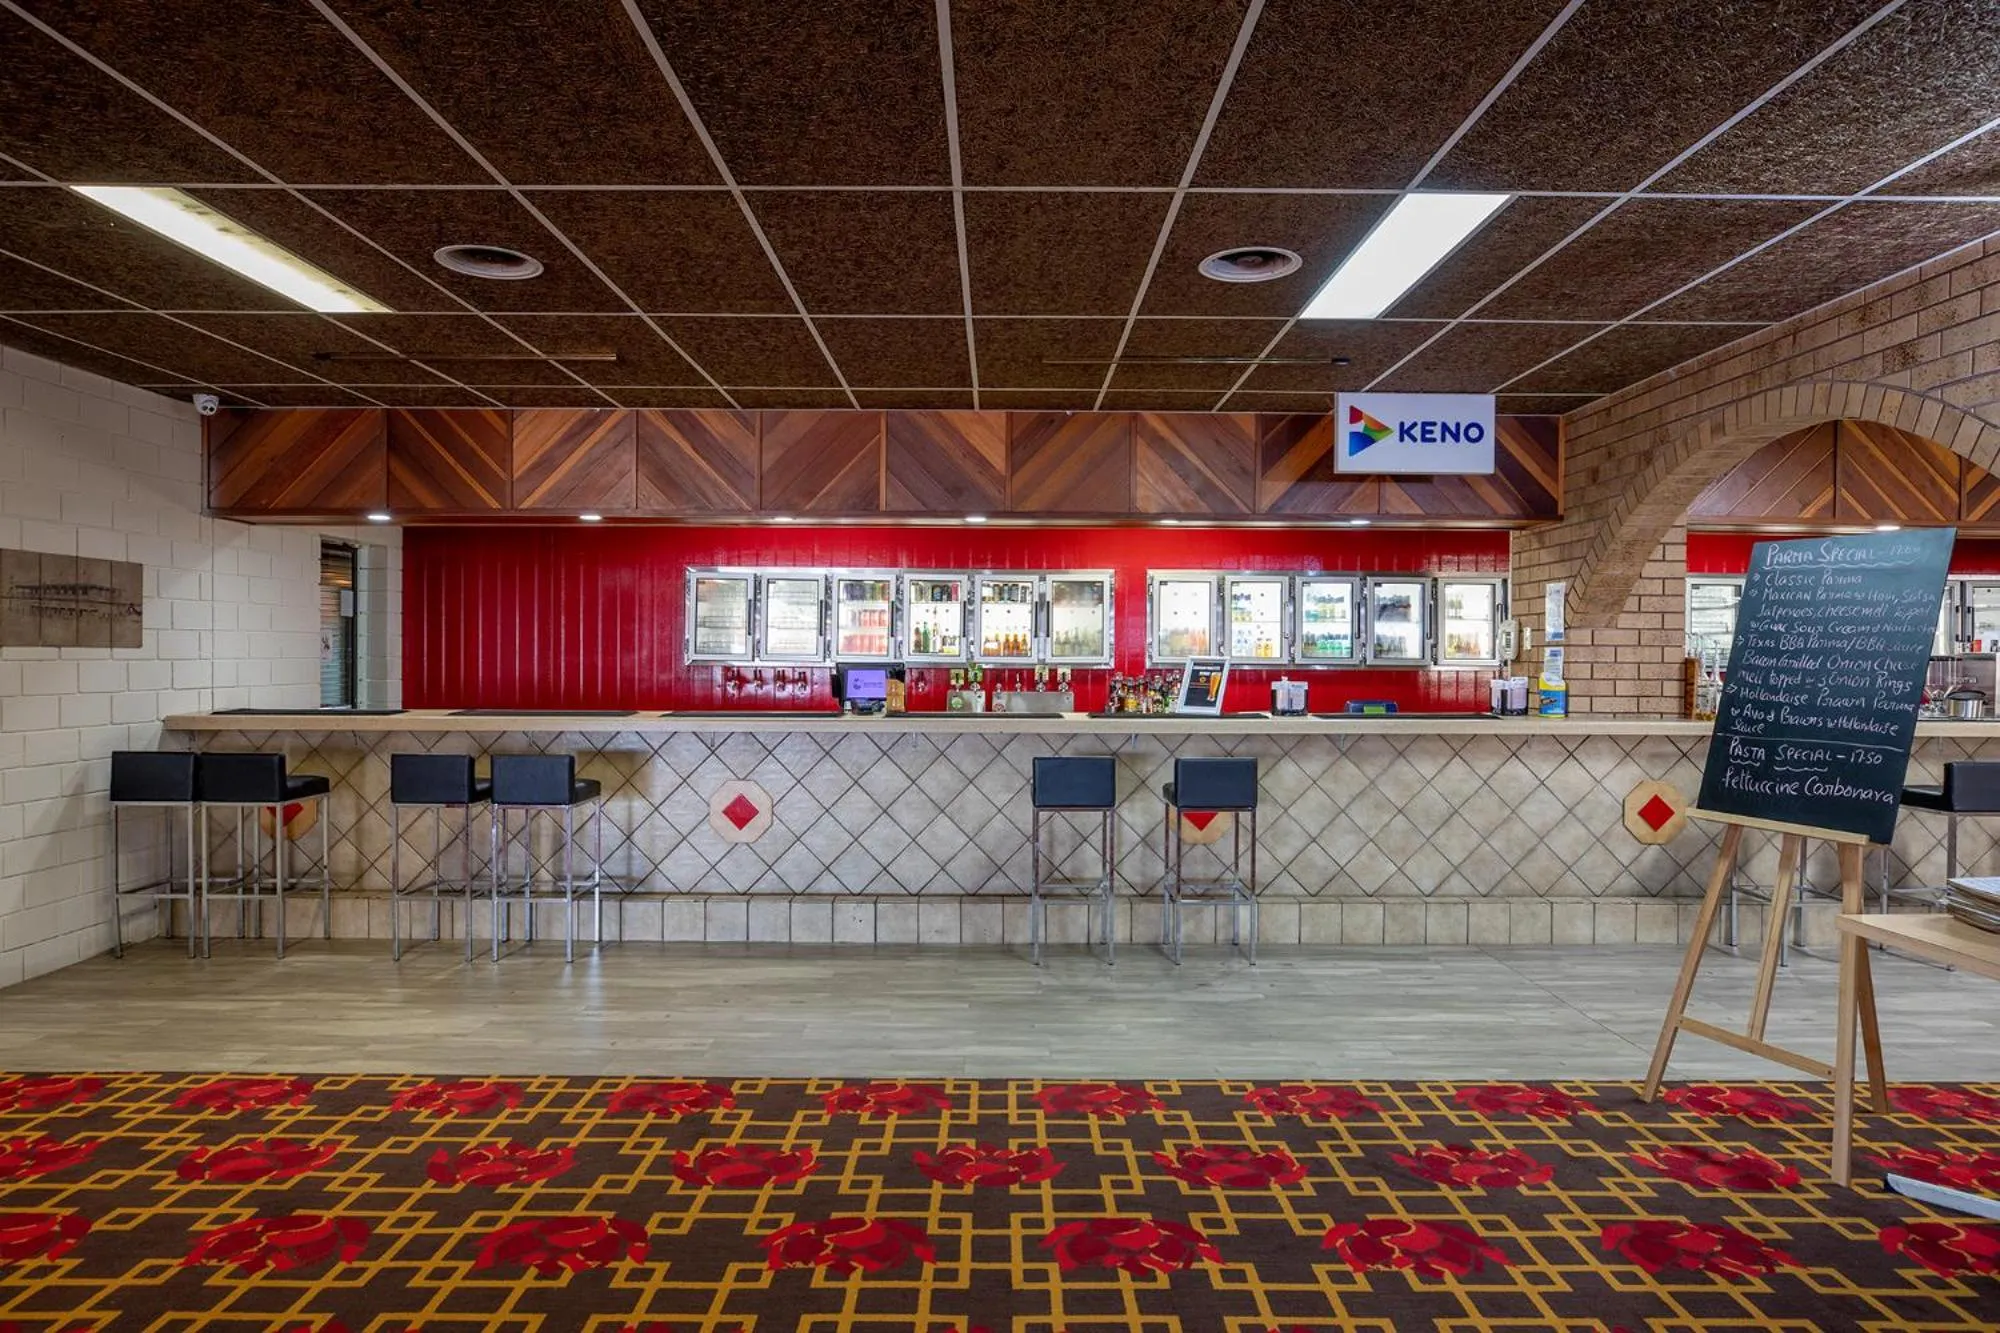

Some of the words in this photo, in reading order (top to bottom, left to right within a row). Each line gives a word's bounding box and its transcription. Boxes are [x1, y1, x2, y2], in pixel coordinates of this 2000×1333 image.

[1399, 421, 1485, 443] KENO
[1817, 541, 1875, 562] SPECIAL
[1765, 571, 1815, 587] Classic
[1742, 650, 1777, 666] Bacon
[1827, 655, 1872, 671] Onion
[1828, 672, 1870, 688] Onion
[1875, 671, 1913, 695] Rings
[1739, 686, 1809, 706] Hollandaise
[1731, 718, 1765, 734] Sauce
[1729, 736, 1765, 760] PASTA
[1775, 744, 1833, 762] SPECIAL
[1804, 775, 1895, 805] Carbonara
